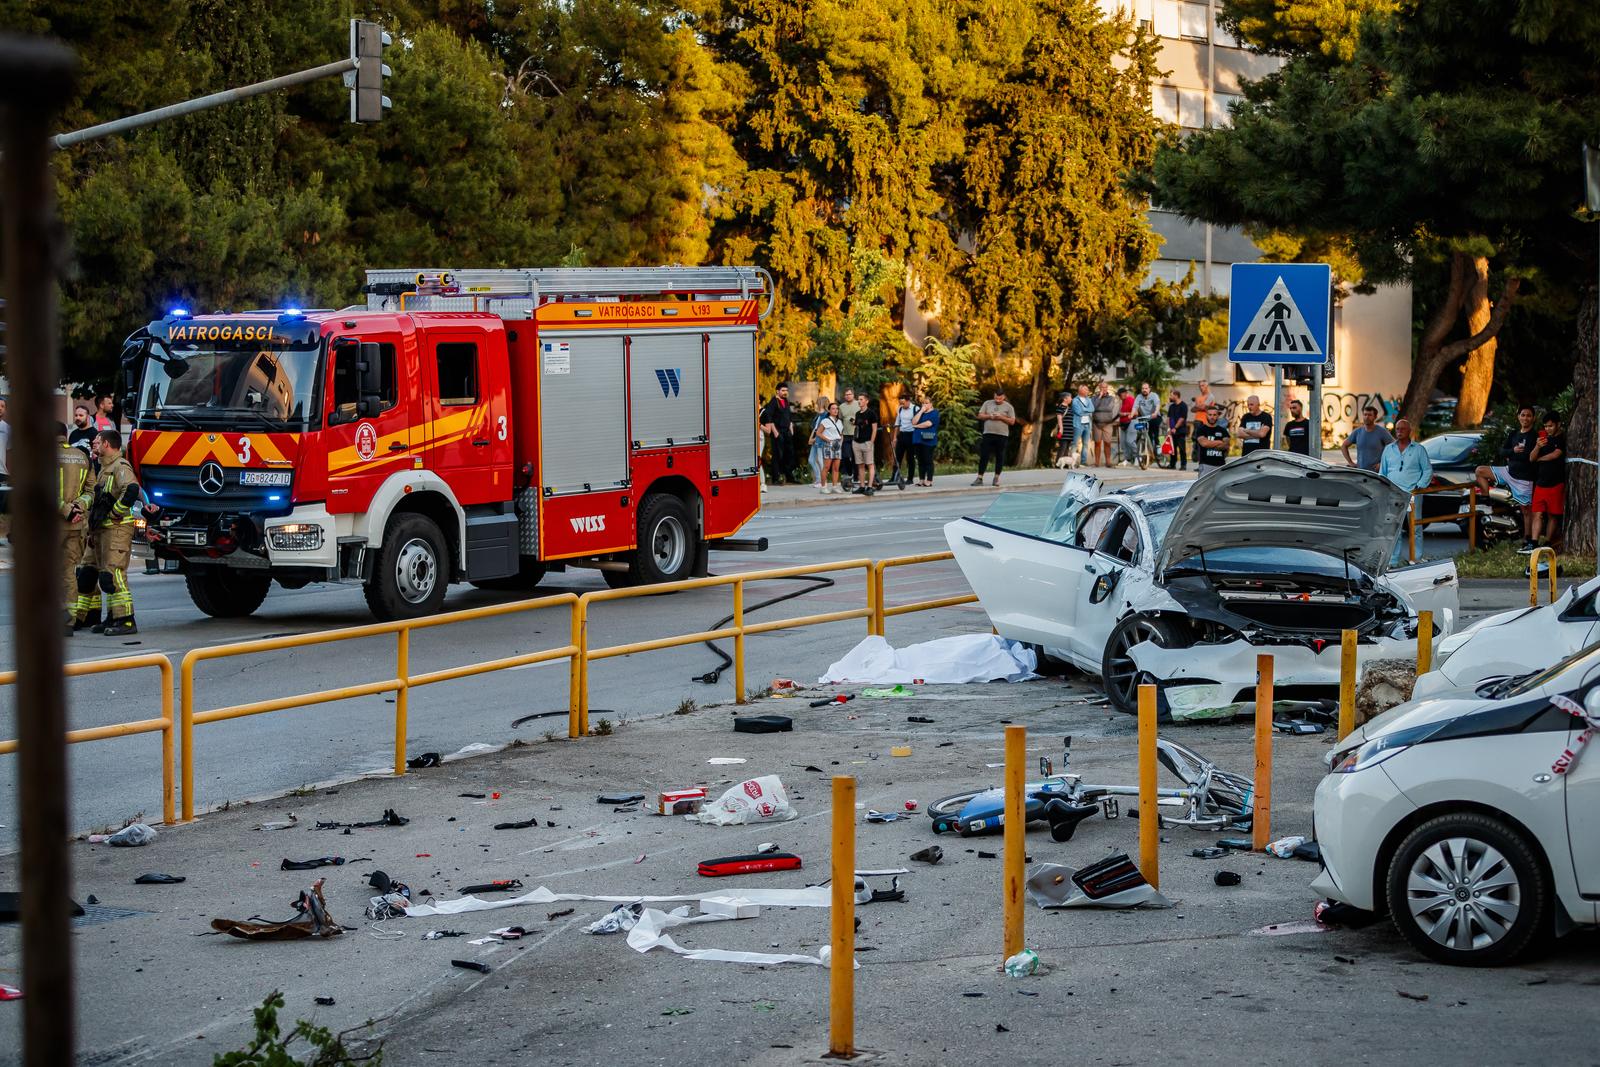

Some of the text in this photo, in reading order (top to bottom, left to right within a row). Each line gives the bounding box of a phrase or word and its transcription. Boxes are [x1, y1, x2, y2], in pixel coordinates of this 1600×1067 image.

[599, 304, 711, 317] VATROGASCI 193
[169, 326, 273, 340] VATROGASCI
[498, 415, 507, 440] 3
[238, 437, 251, 464] 3
[245, 473, 255, 483] ZG
[569, 515, 606, 534] WISS
